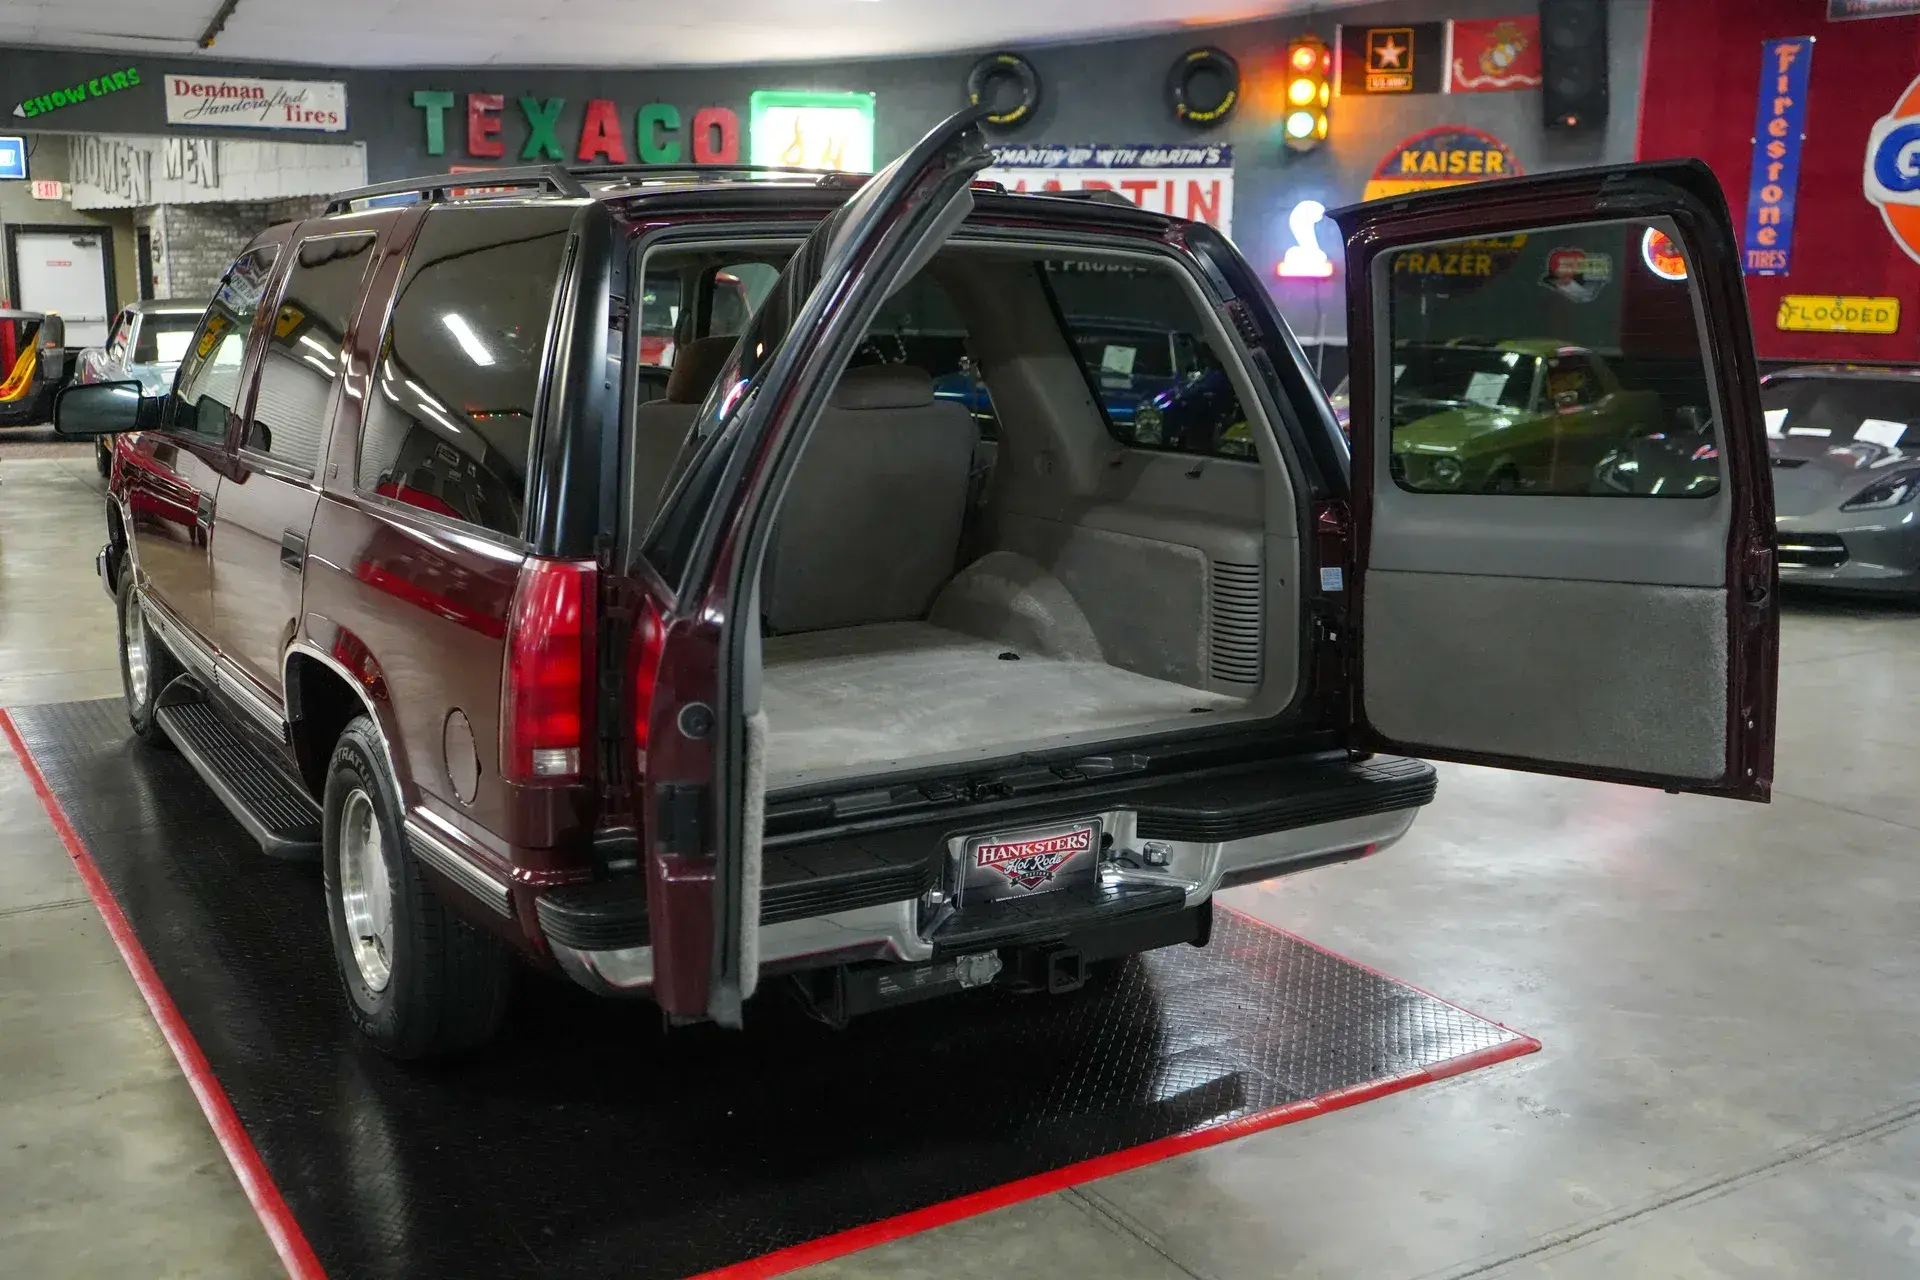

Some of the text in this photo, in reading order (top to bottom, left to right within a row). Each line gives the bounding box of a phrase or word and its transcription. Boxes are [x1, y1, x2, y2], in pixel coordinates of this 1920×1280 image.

[23, 67, 140, 117] SHOW CARS
[174, 79, 264, 99] Denman
[184, 85, 308, 121] Handcrafted
[283, 103, 338, 124] Tires
[413, 90, 739, 165] TEXACO
[1757, 44, 1802, 246] Firestone
[69, 135, 150, 202] WOMEN
[163, 138, 219, 188] MEN
[1401, 150, 1503, 174] KAISER
[37, 183, 59, 197] EXIT
[1394, 253, 1492, 276] FRAZER
[1747, 250, 1787, 269] TIRES
[1784, 304, 1889, 324] FLOODED
[980, 833, 1089, 864] HANKSTERS
[1004, 853, 1063, 874] Hot Rods
